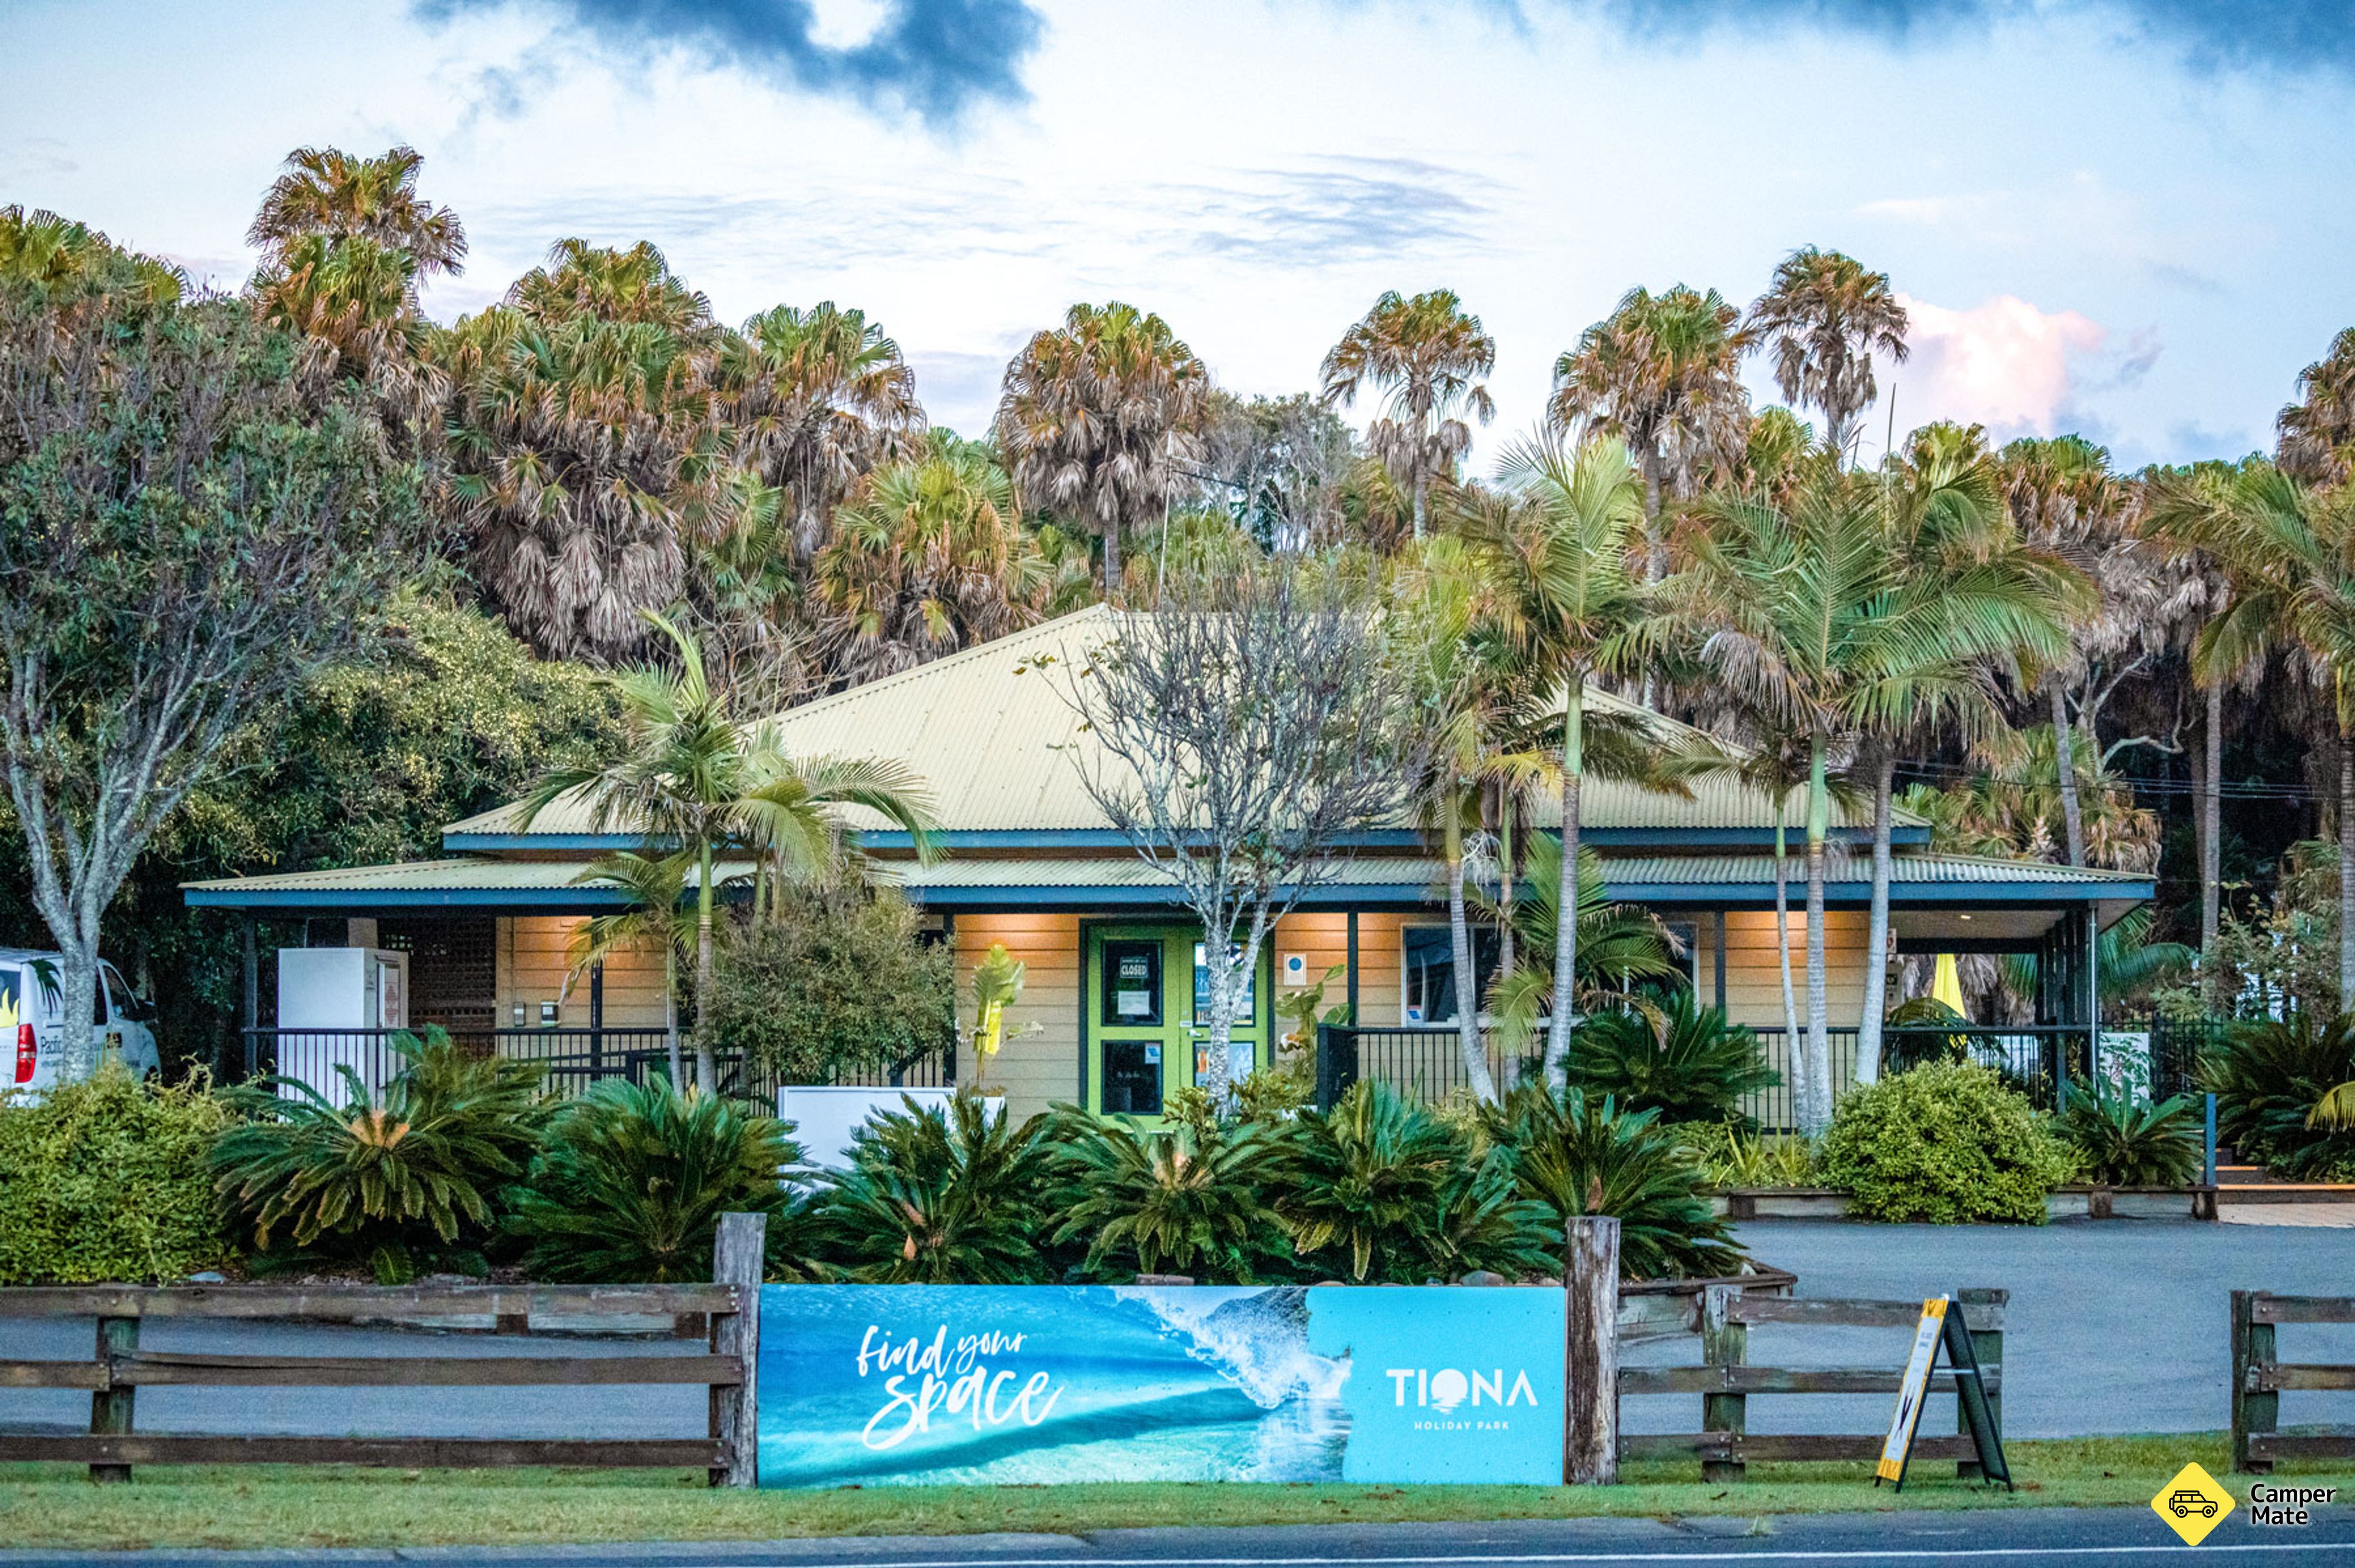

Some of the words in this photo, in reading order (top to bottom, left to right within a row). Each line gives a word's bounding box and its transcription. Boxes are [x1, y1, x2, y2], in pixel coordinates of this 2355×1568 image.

[1121, 965, 1147, 975] CLOSED
[856, 1324, 955, 1378] find
[956, 1330, 1027, 1374] your
[862, 1365, 1064, 1450] space
[1386, 1368, 1538, 1414] TIONA
[1414, 1421, 1471, 1430] HOLIDAY
[1477, 1421, 1509, 1430] PARK
